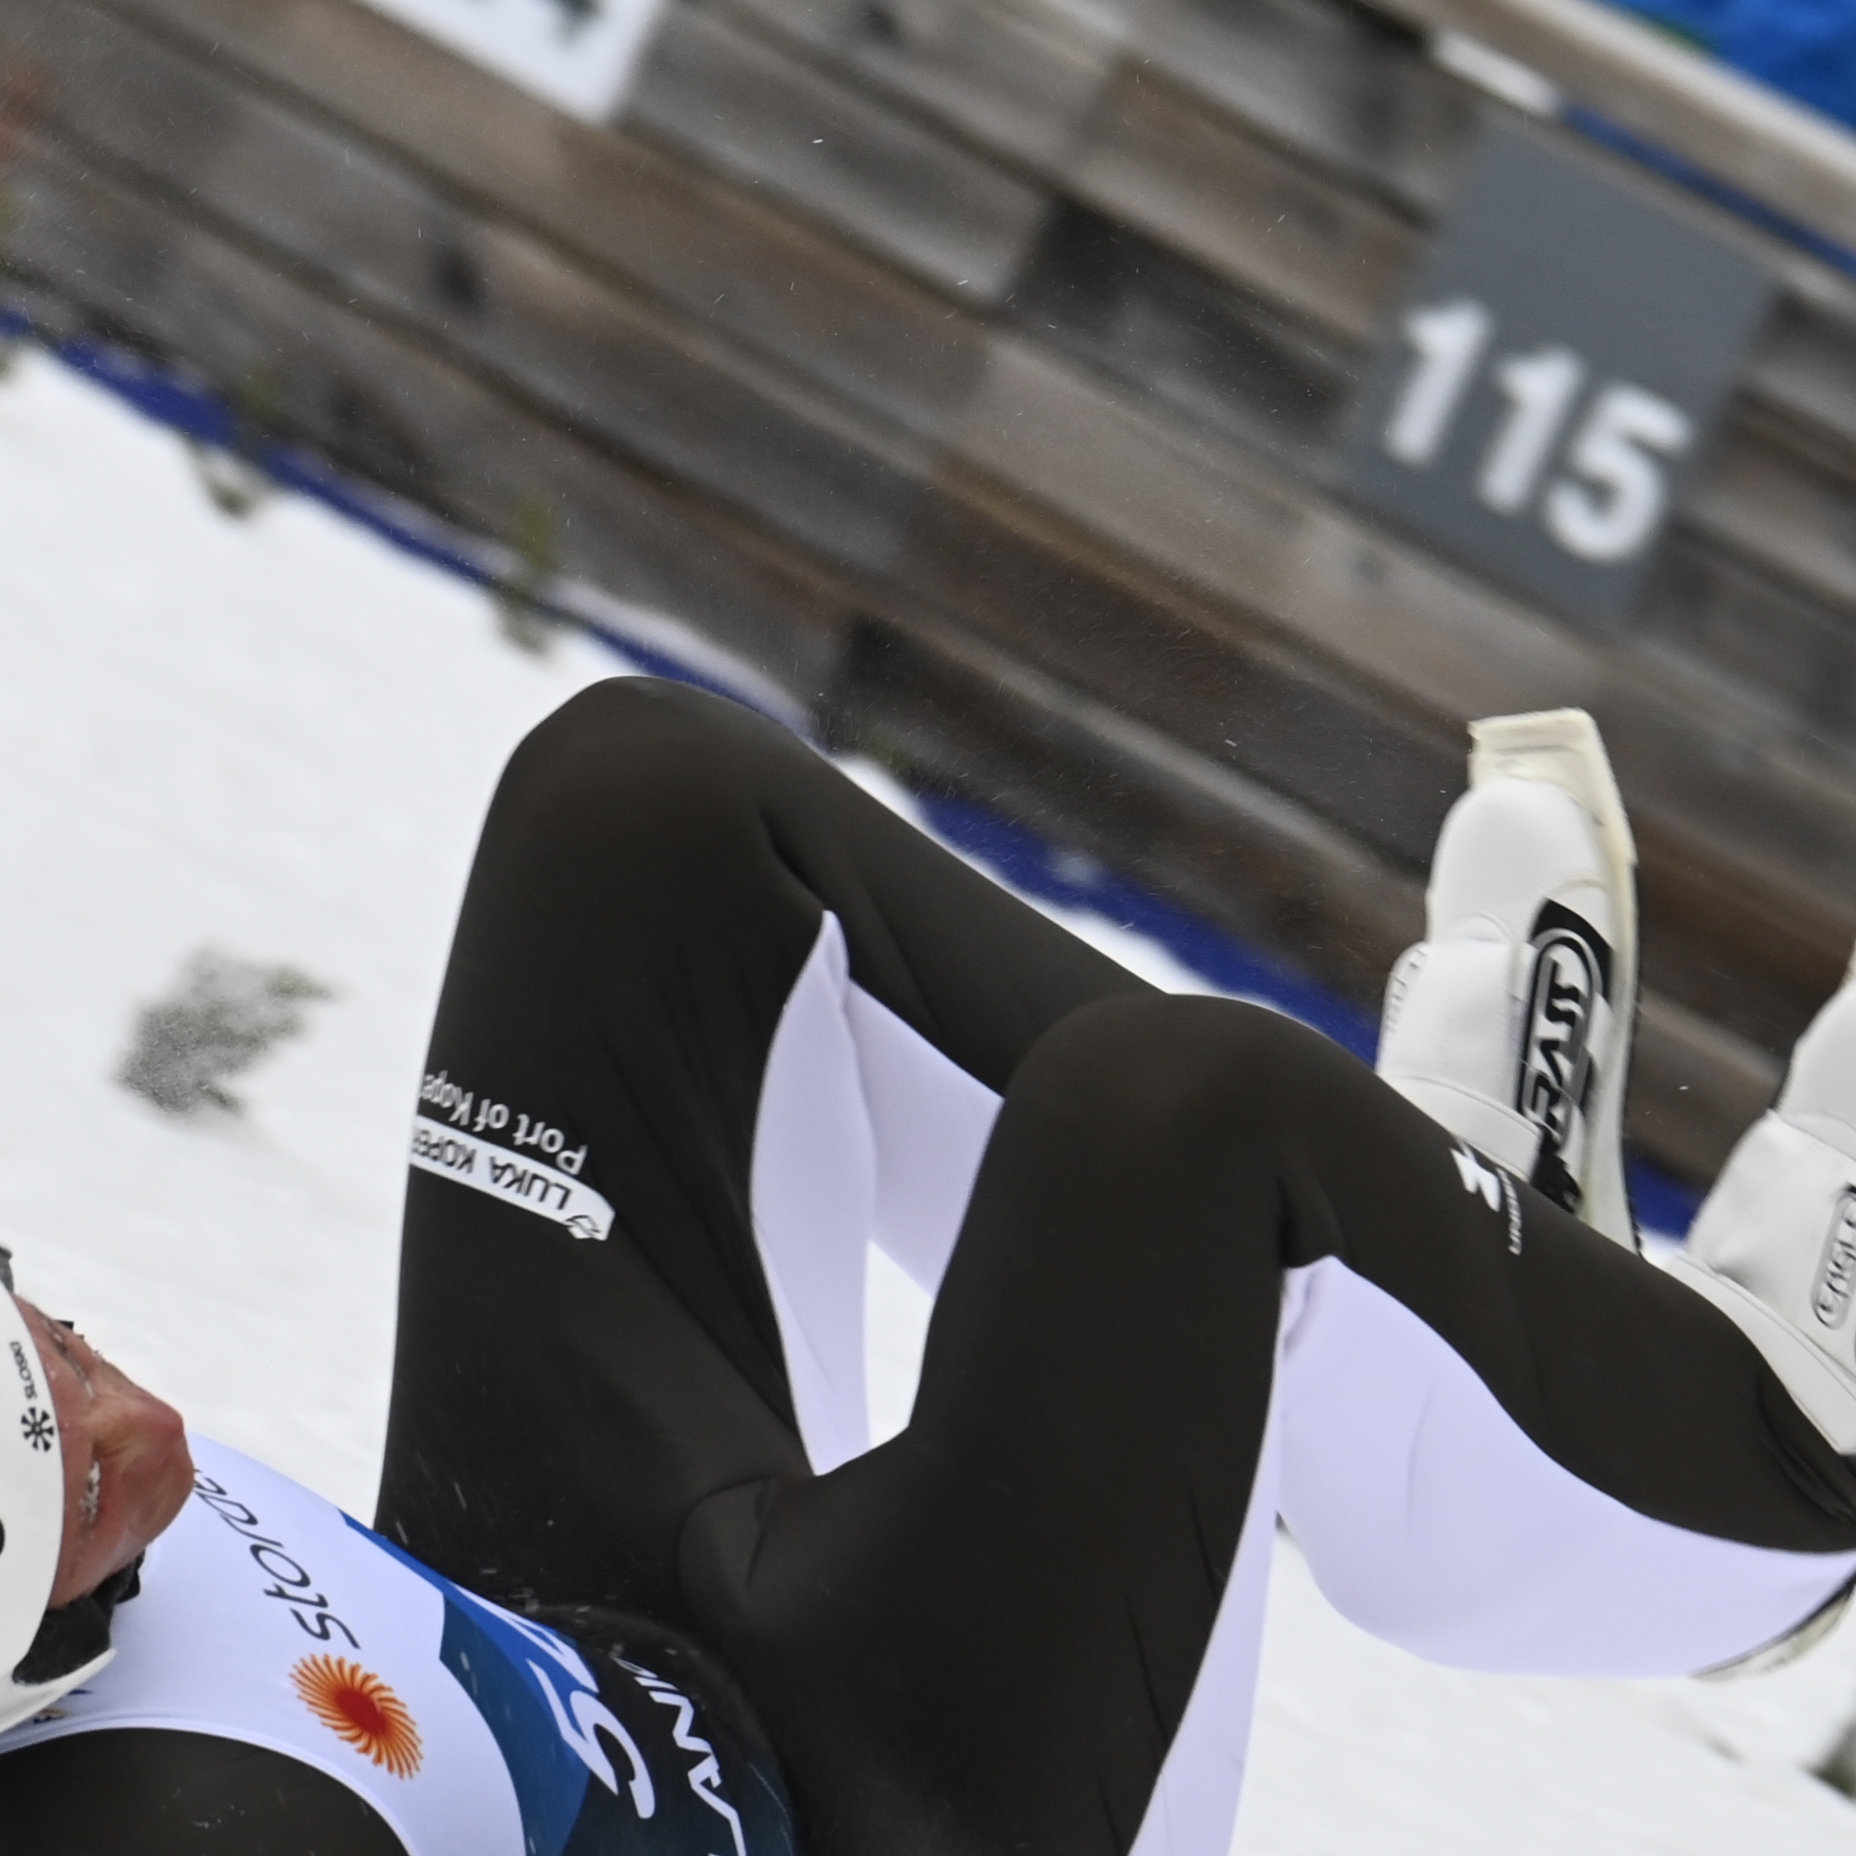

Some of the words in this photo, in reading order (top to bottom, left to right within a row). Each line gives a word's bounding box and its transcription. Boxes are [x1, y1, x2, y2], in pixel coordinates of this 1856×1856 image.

[1385, 298, 1692, 562] 115
[472, 1098, 510, 1132] of
[511, 1113, 589, 1176] Port
[489, 1155, 572, 1211] LUKA
